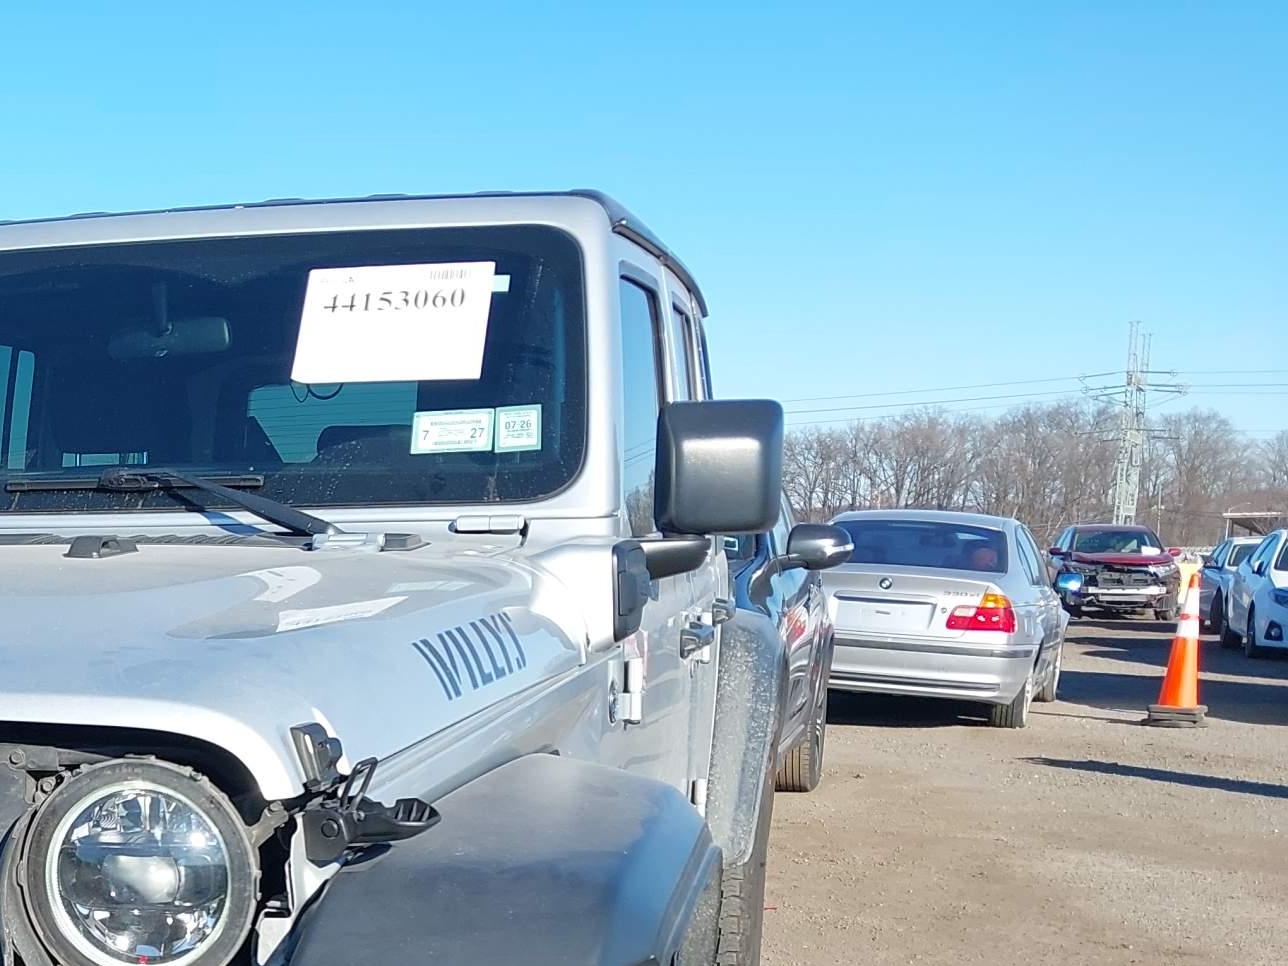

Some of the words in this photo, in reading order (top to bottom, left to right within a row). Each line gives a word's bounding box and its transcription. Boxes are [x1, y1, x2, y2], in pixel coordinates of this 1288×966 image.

[323, 287, 467, 313] 44153060
[470, 427, 485, 439] 27
[411, 611, 527, 701] WILLYS
